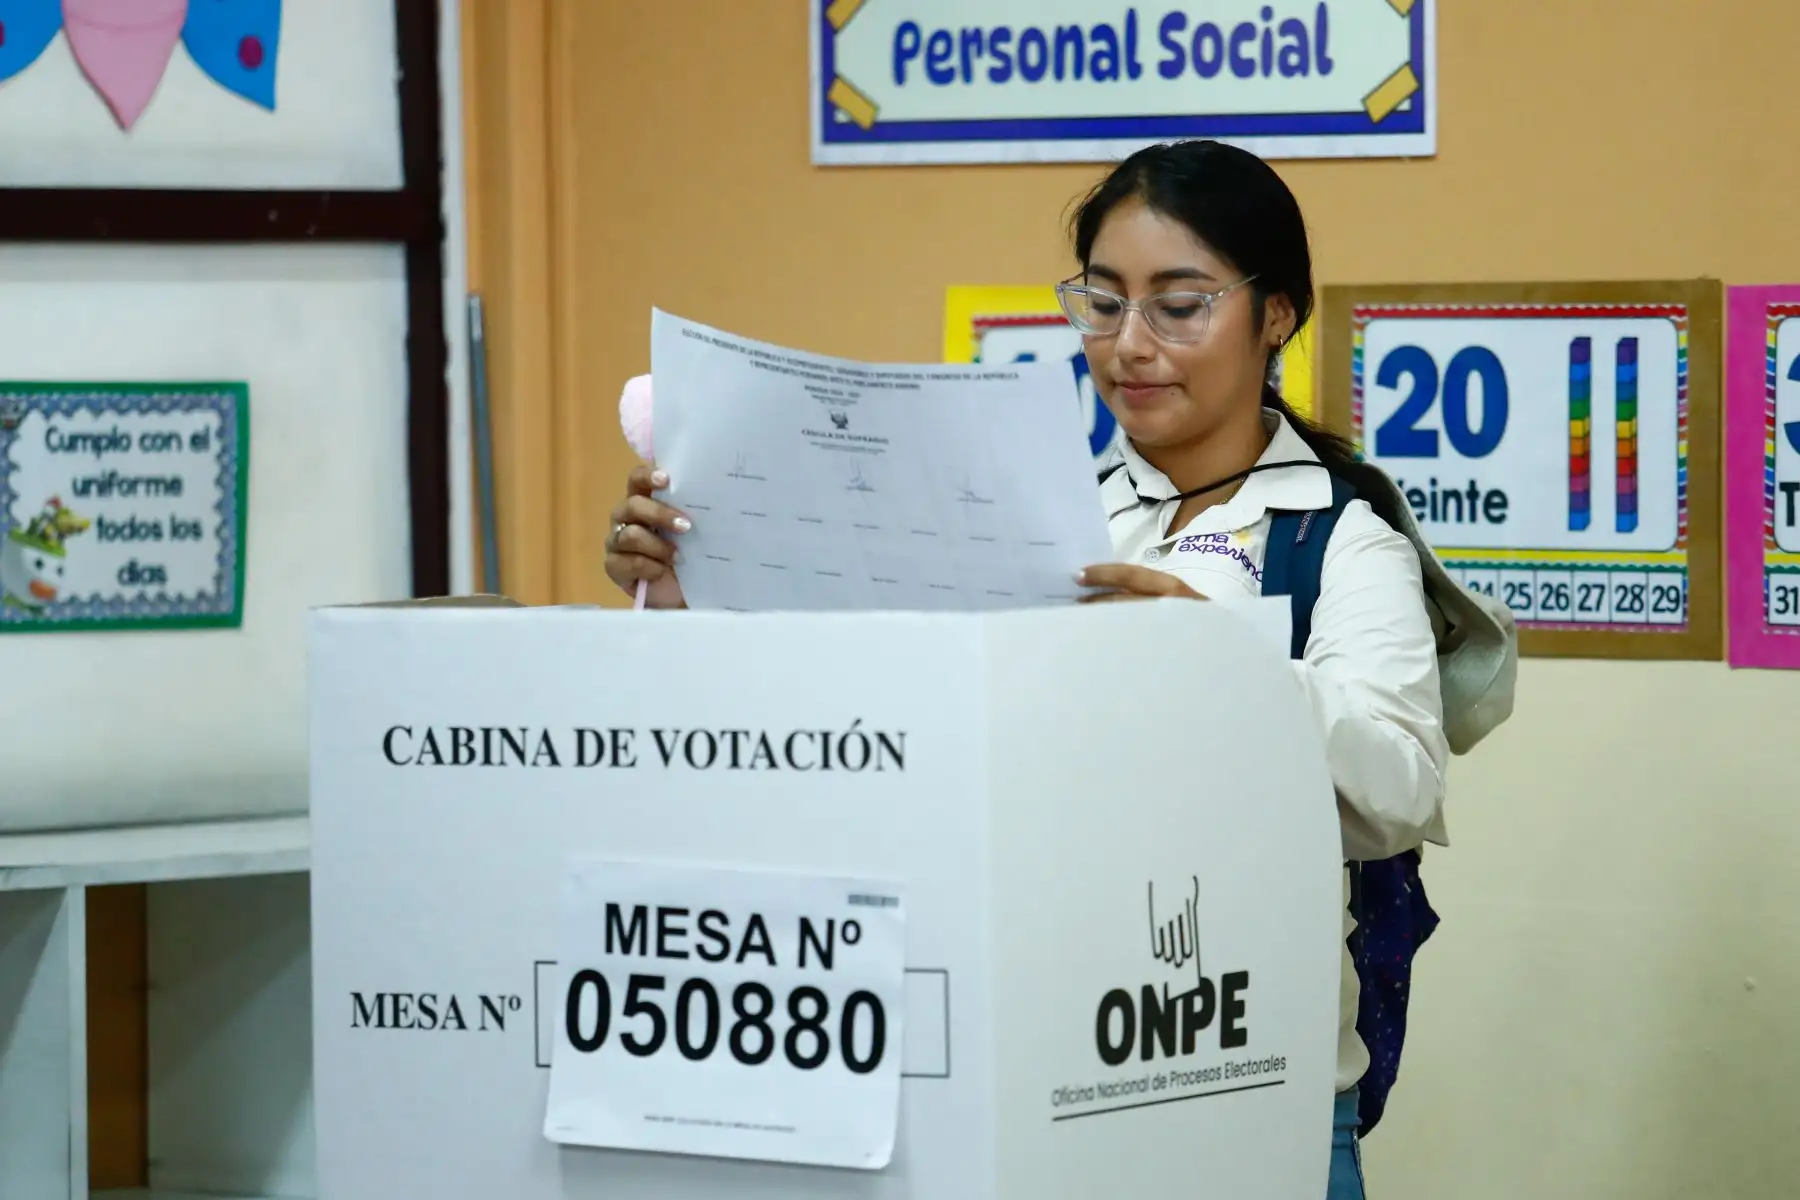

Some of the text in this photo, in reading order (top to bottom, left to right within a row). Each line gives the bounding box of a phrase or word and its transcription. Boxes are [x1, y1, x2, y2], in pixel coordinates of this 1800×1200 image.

[893, 2, 1333, 86] Personal Social
[1375, 345, 1509, 459] 20
[45, 425, 210, 458] Cumplo con el
[72, 471, 184, 498] uniforme
[1397, 477, 1509, 524] einte
[97, 515, 203, 541] todos los
[1178, 543, 1262, 582] experienc
[1504, 581, 1532, 611] 25
[1540, 584, 1570, 612] 26
[1576, 583, 1606, 612] 27
[1615, 583, 1647, 614] 28
[1651, 584, 1681, 614] 29
[1774, 586, 1800, 616] 31
[382, 720, 907, 773] CABINA DE VOTACIÓN
[604, 902, 777, 966] MESA
[350, 992, 468, 1031] MESA
[564, 969, 887, 1074] 050880
[1096, 970, 1249, 1066] ONPE
[1051, 1054, 1287, 1107] Oficina Nacional de Procesos Electorales
